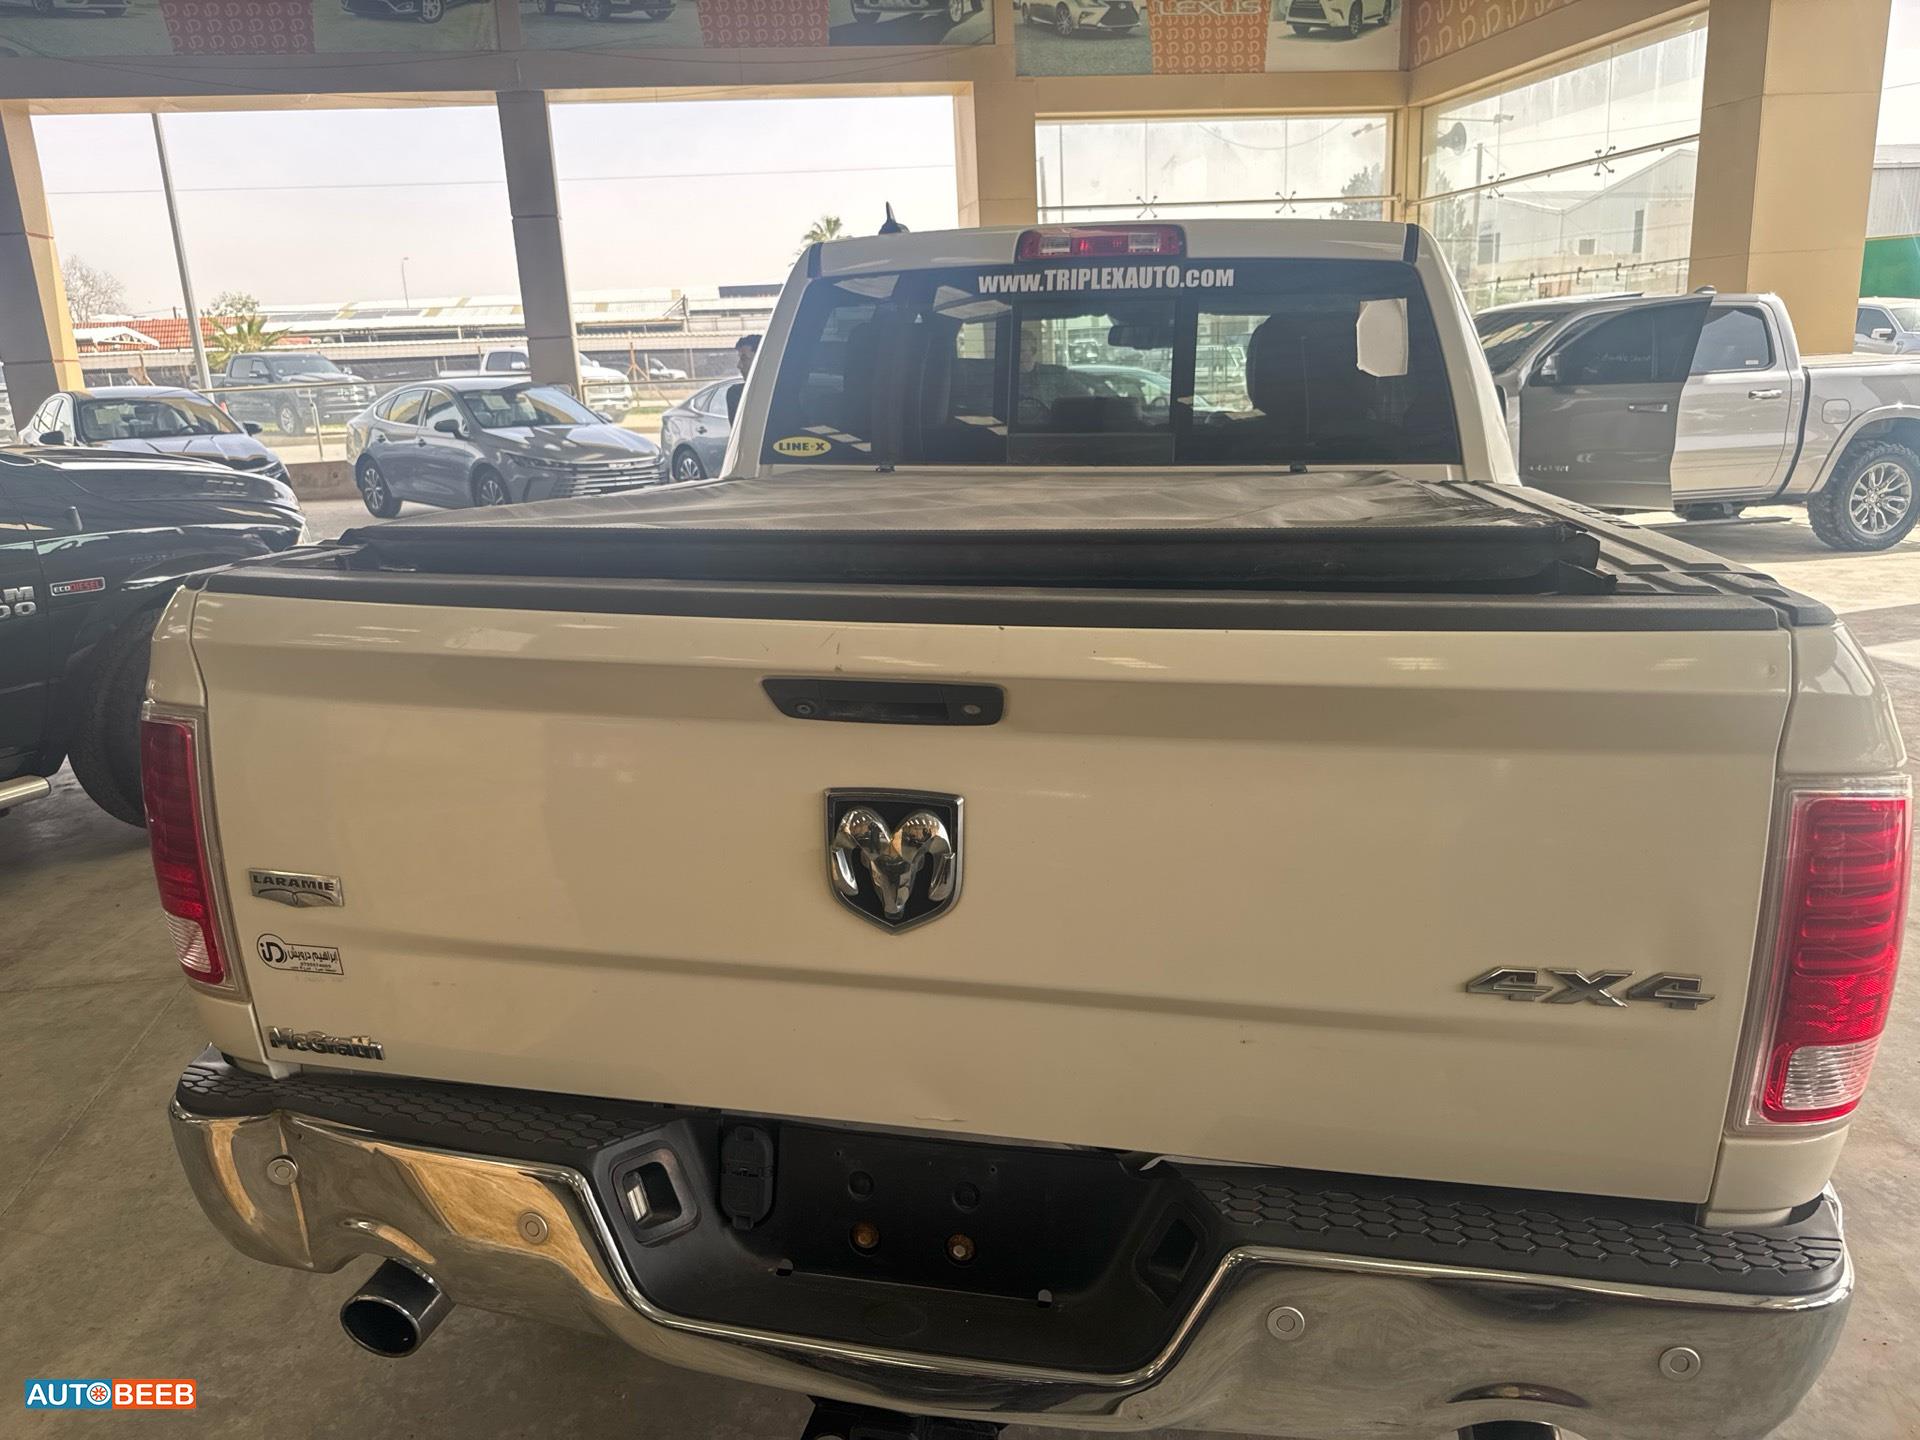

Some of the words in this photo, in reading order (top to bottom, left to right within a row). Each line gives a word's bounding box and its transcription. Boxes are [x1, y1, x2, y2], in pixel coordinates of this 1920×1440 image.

[1158, 0, 1262, 15] LEXUS
[778, 442, 826, 451] LINE-X
[53, 580, 100, 593] ECODIESEL
[253, 875, 335, 892] LARAMIE
[1466, 967, 1716, 1010] 4X4
[266, 1026, 386, 1061] McGrath
